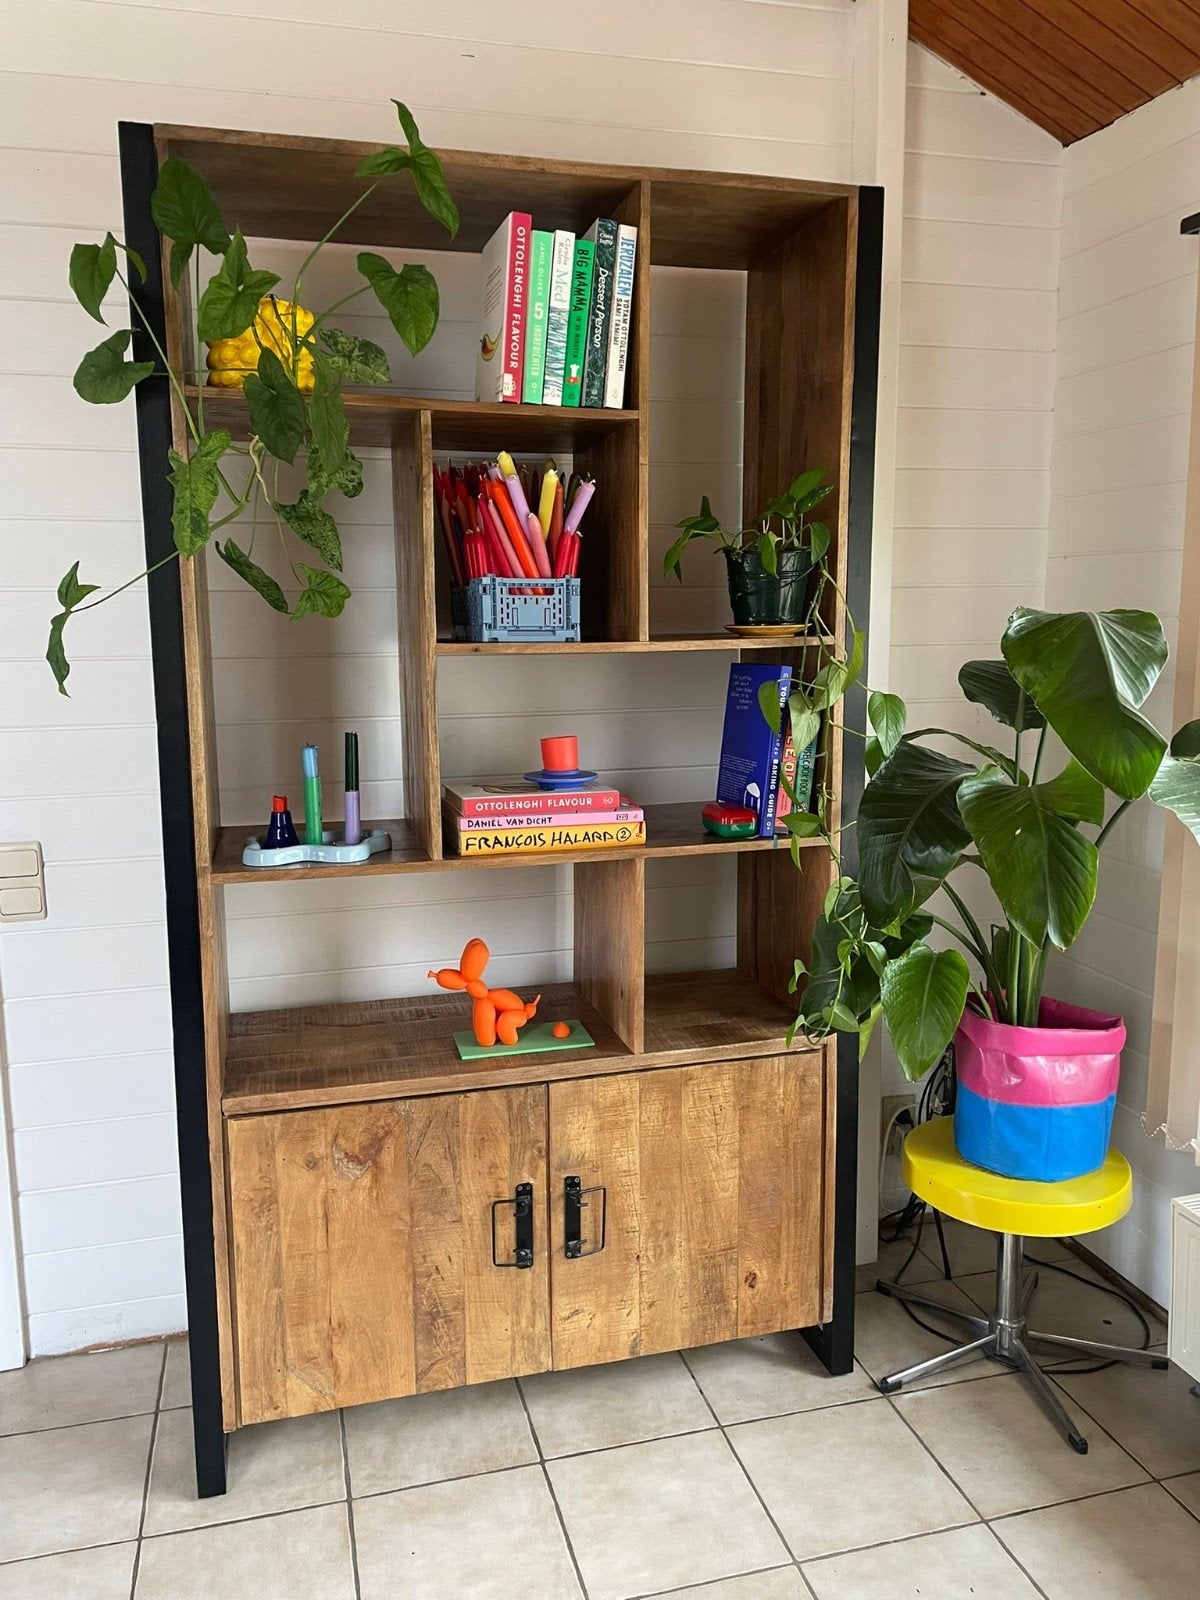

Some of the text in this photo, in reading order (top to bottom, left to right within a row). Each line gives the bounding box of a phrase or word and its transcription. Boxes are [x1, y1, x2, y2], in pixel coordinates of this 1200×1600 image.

[577, 248, 589, 267] BIG
[509, 226, 527, 369] OTTOLENGHI FLAVOUR
[554, 269, 569, 303] Med
[572, 271, 588, 312] MAMMA
[533, 302, 544, 320] 5
[593, 267, 609, 348] Dessert Person
[616, 236, 635, 372] JERUZALEM YOTAM OTTOLENGHI
[612, 297, 623, 346] SAMI TAMIMI
[779, 685, 788, 708] YOUR
[769, 759, 779, 790] BAKING
[800, 759, 813, 797] COOKBOOK
[475, 797, 593, 811] OTTOLENGHI FLAVOUR
[766, 793, 776, 818] GUIDE
[506, 818, 524, 826] VAN
[526, 816, 553, 826] DICHT
[465, 831, 546, 851] FRANÇOIS
[550, 830, 614, 848] HALARD
